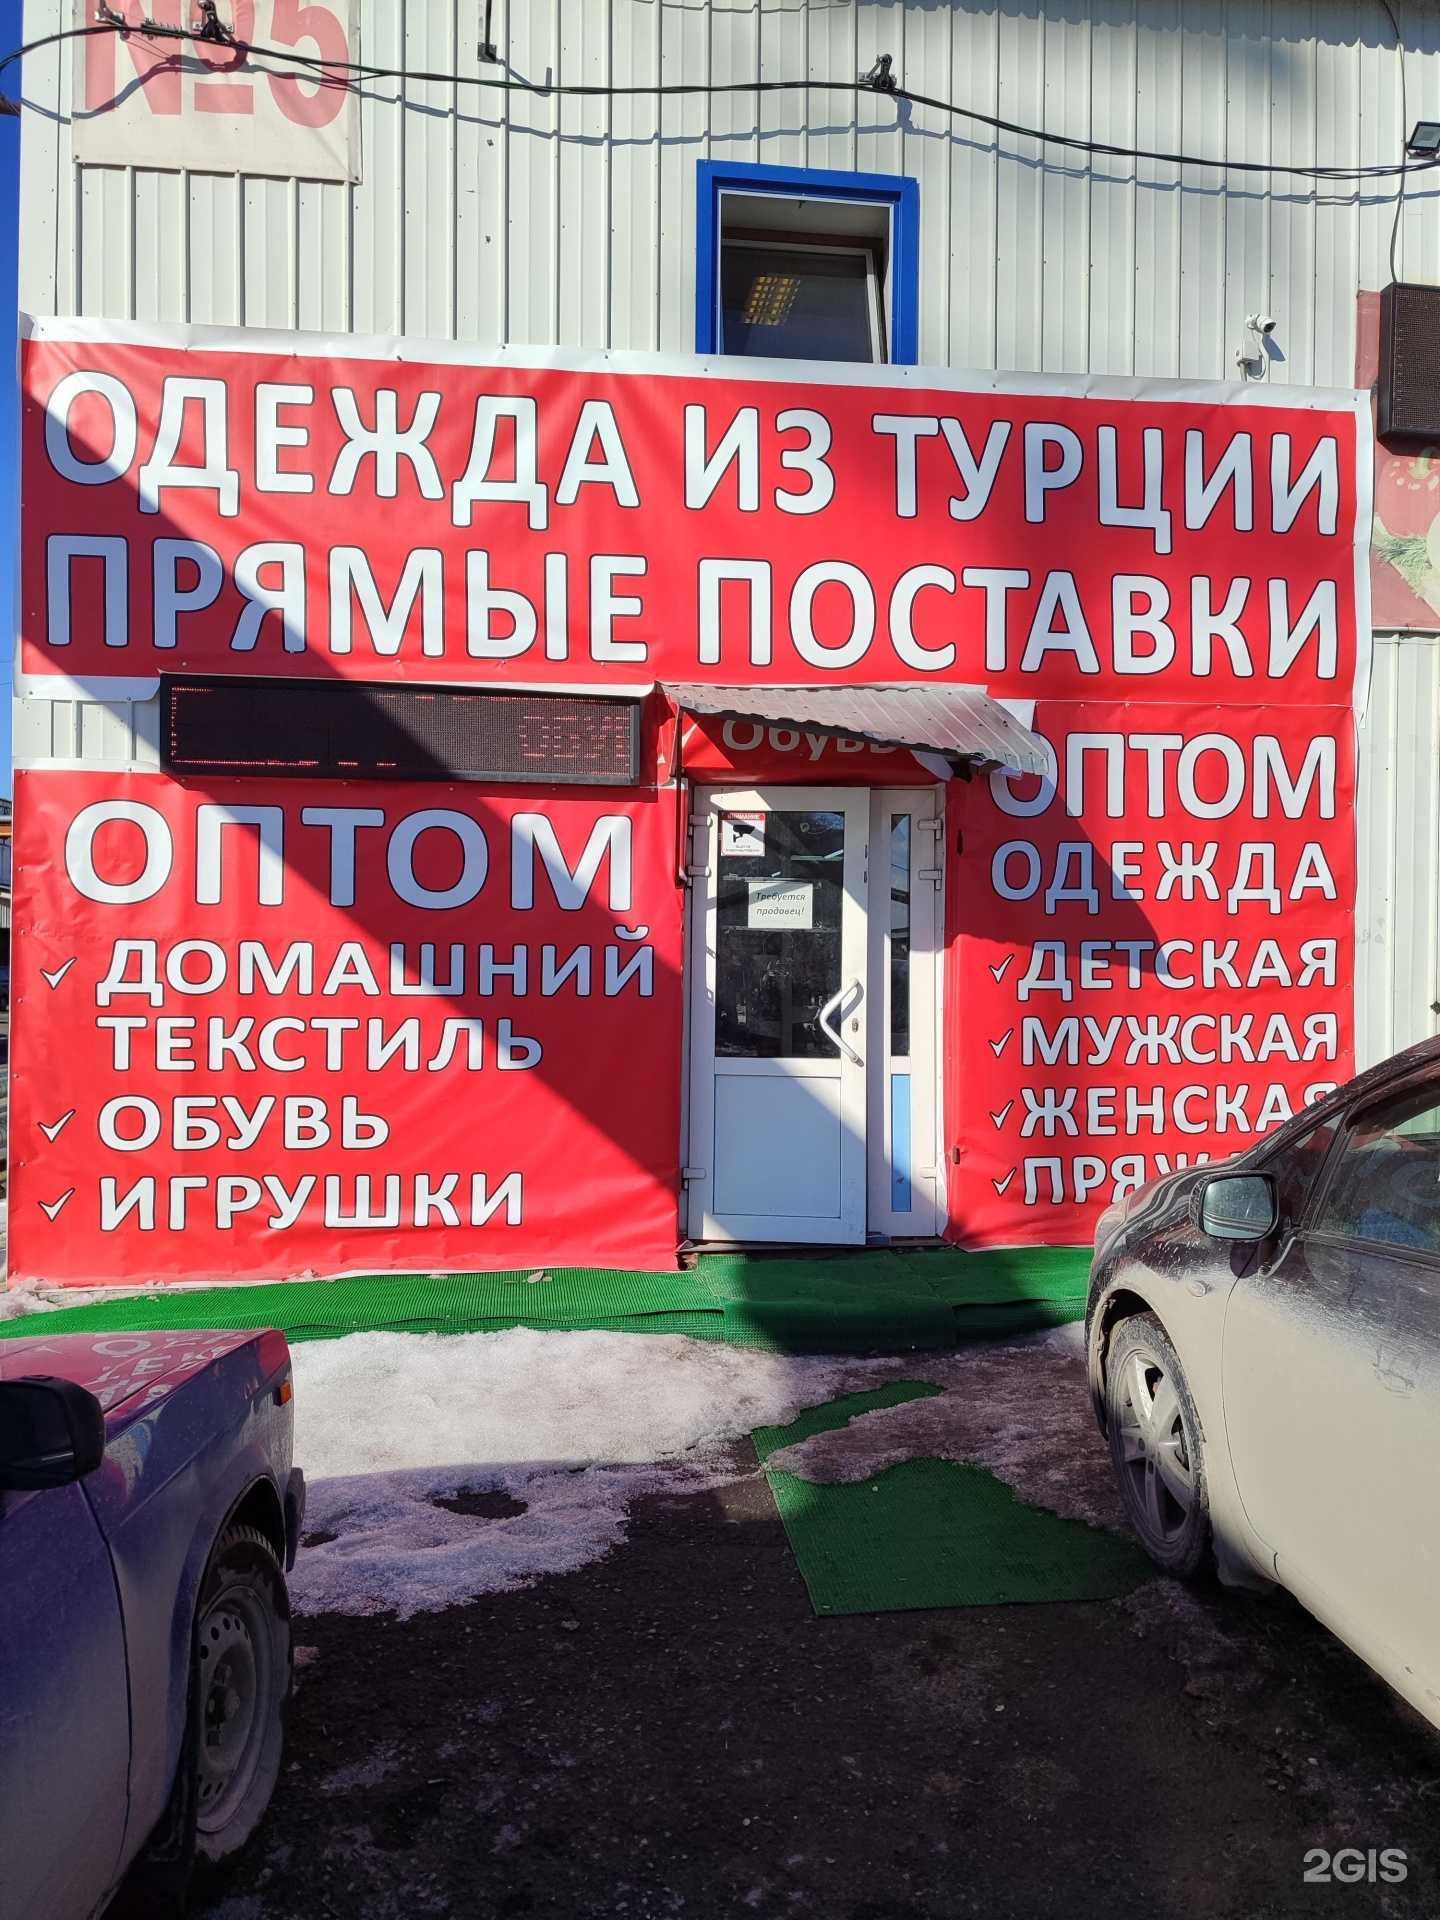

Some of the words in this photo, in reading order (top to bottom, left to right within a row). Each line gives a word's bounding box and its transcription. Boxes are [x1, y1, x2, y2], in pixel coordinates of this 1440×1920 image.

[44, 371, 640, 531] ОДЕЖДА
[684, 404, 836, 515] ИЗ
[873, 413, 1338, 555] ТУРЦИИ
[46, 534, 648, 664] ПРЯМЫЕ
[698, 557, 1337, 680] ПОСТАВКИ
[989, 730, 1337, 820] ОПТОМ
[64, 799, 633, 912] ОПТОМ
[991, 840, 1338, 915] ОДЕЖДА
[756, 892, 806, 902] Требуется
[756, 907, 805, 917] продавец!
[96, 925, 654, 1007] ДОМАШНИЙ
[1017, 939, 1338, 1002] ДЕТСКАЯ
[97, 1016, 543, 1072] ТЕКСТИЛЬ
[1021, 1013, 1338, 1067] МУЖСКАЯ
[98, 1095, 390, 1151] ОБУВЬ
[100, 1172, 524, 1231] ИГРУШКИ
